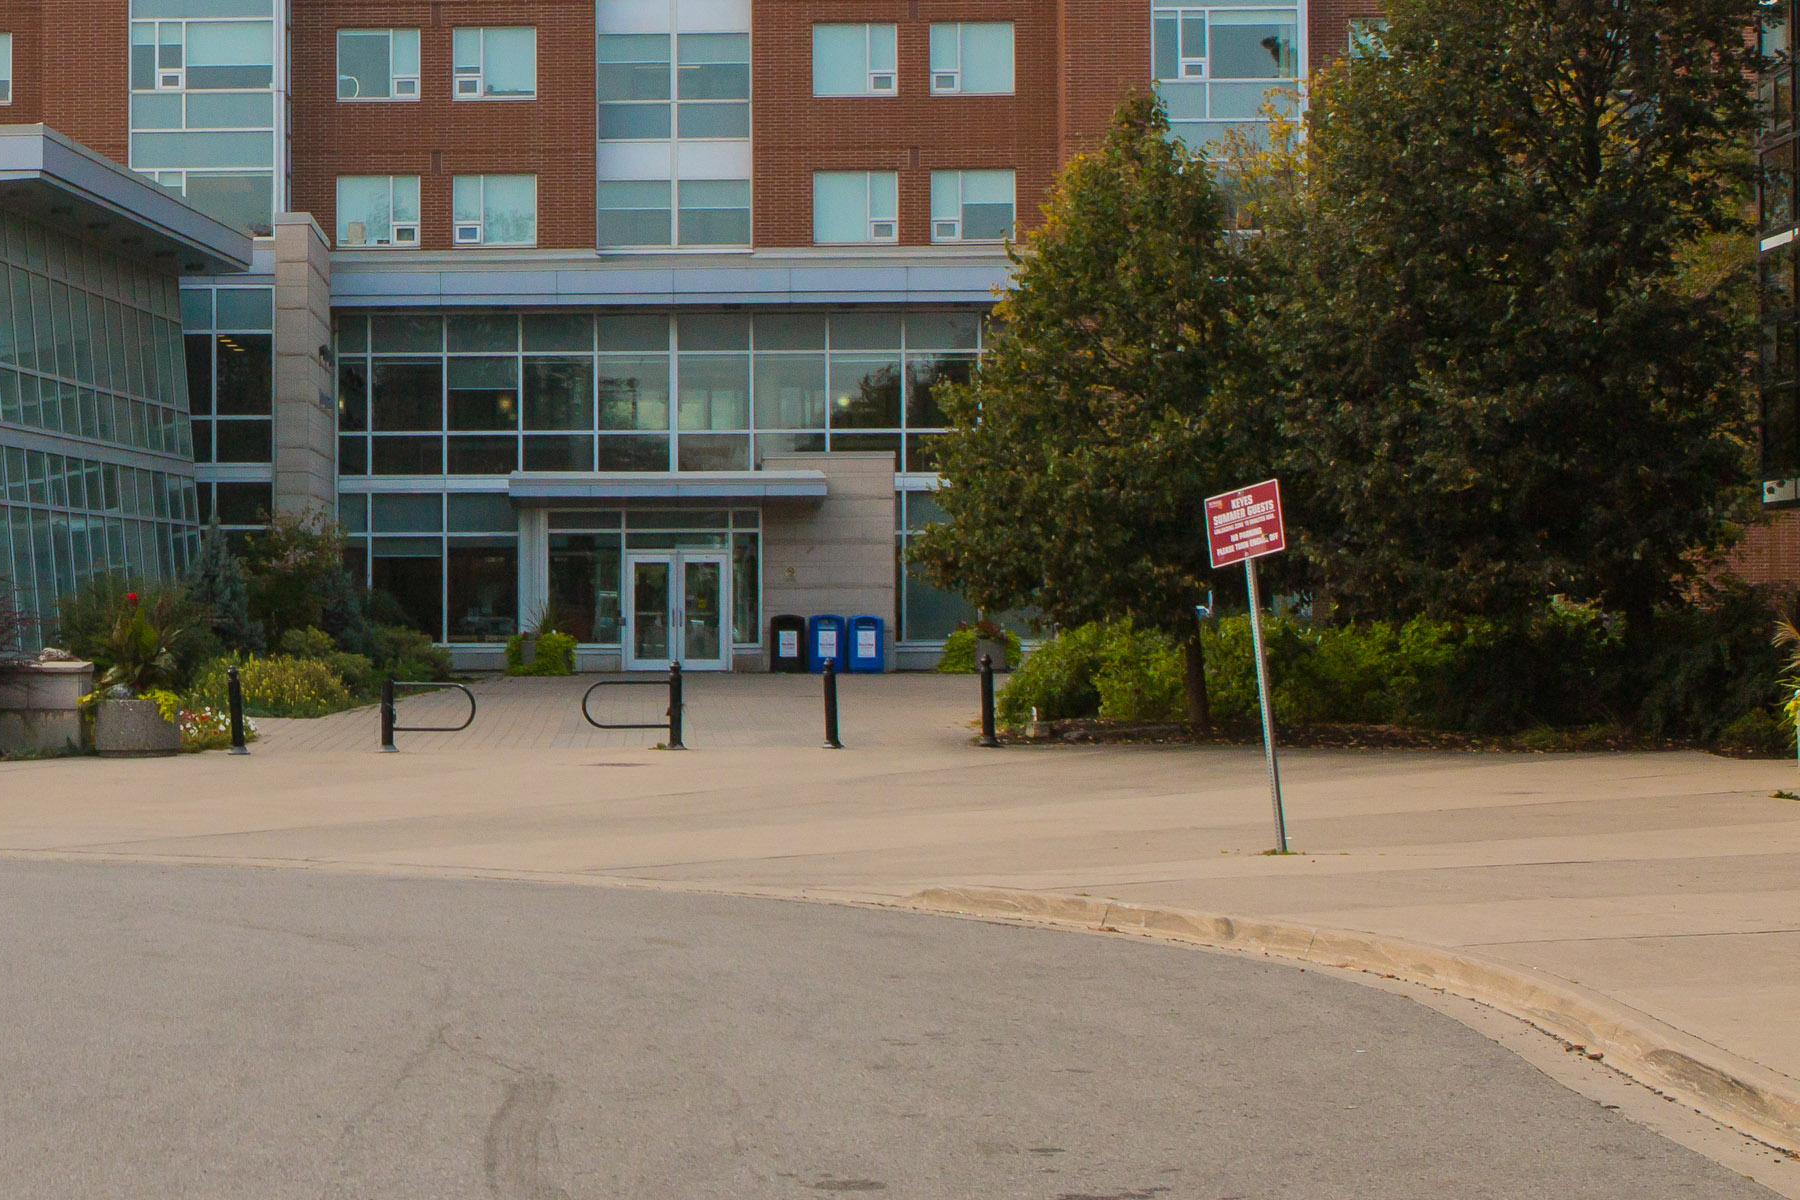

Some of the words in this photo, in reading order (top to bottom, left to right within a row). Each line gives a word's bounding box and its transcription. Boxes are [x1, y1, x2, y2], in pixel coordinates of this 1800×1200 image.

[1230, 494, 1253, 509] KEYES
[1213, 508, 1245, 526] SUMMER
[1246, 499, 1274, 515] GUESTS
[1216, 544, 1234, 556] PLEASE
[1235, 541, 1248, 551] TURN
[1268, 532, 1278, 541] OFF
[1230, 533, 1238, 542] NO
[1239, 526, 1262, 540] PARKING
